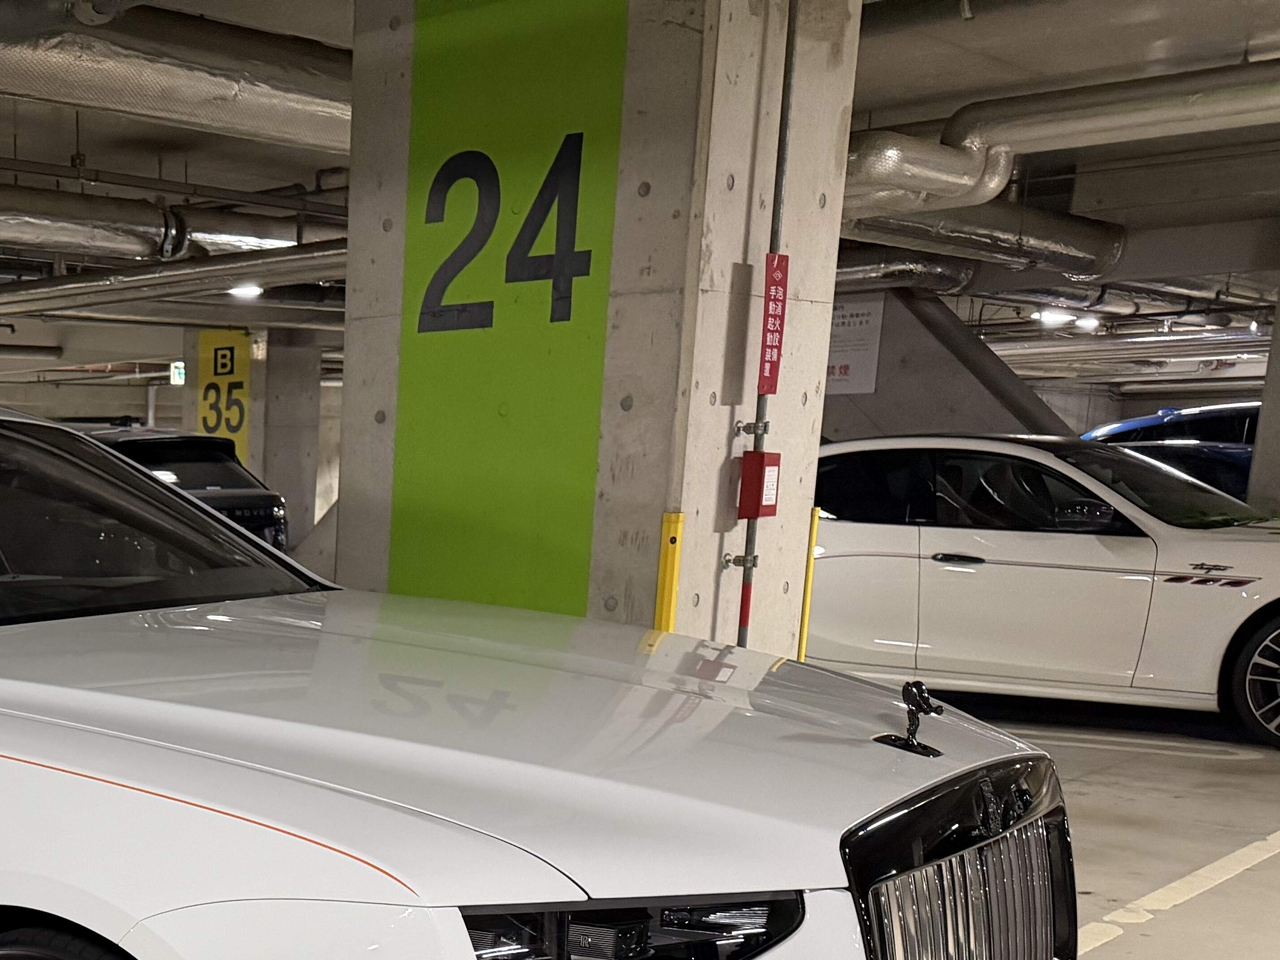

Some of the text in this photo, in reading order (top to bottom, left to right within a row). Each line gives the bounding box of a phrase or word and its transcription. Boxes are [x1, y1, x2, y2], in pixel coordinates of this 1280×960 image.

[417, 132, 592, 333] 24
[216, 349, 232, 375] B
[202, 381, 245, 434] 35
